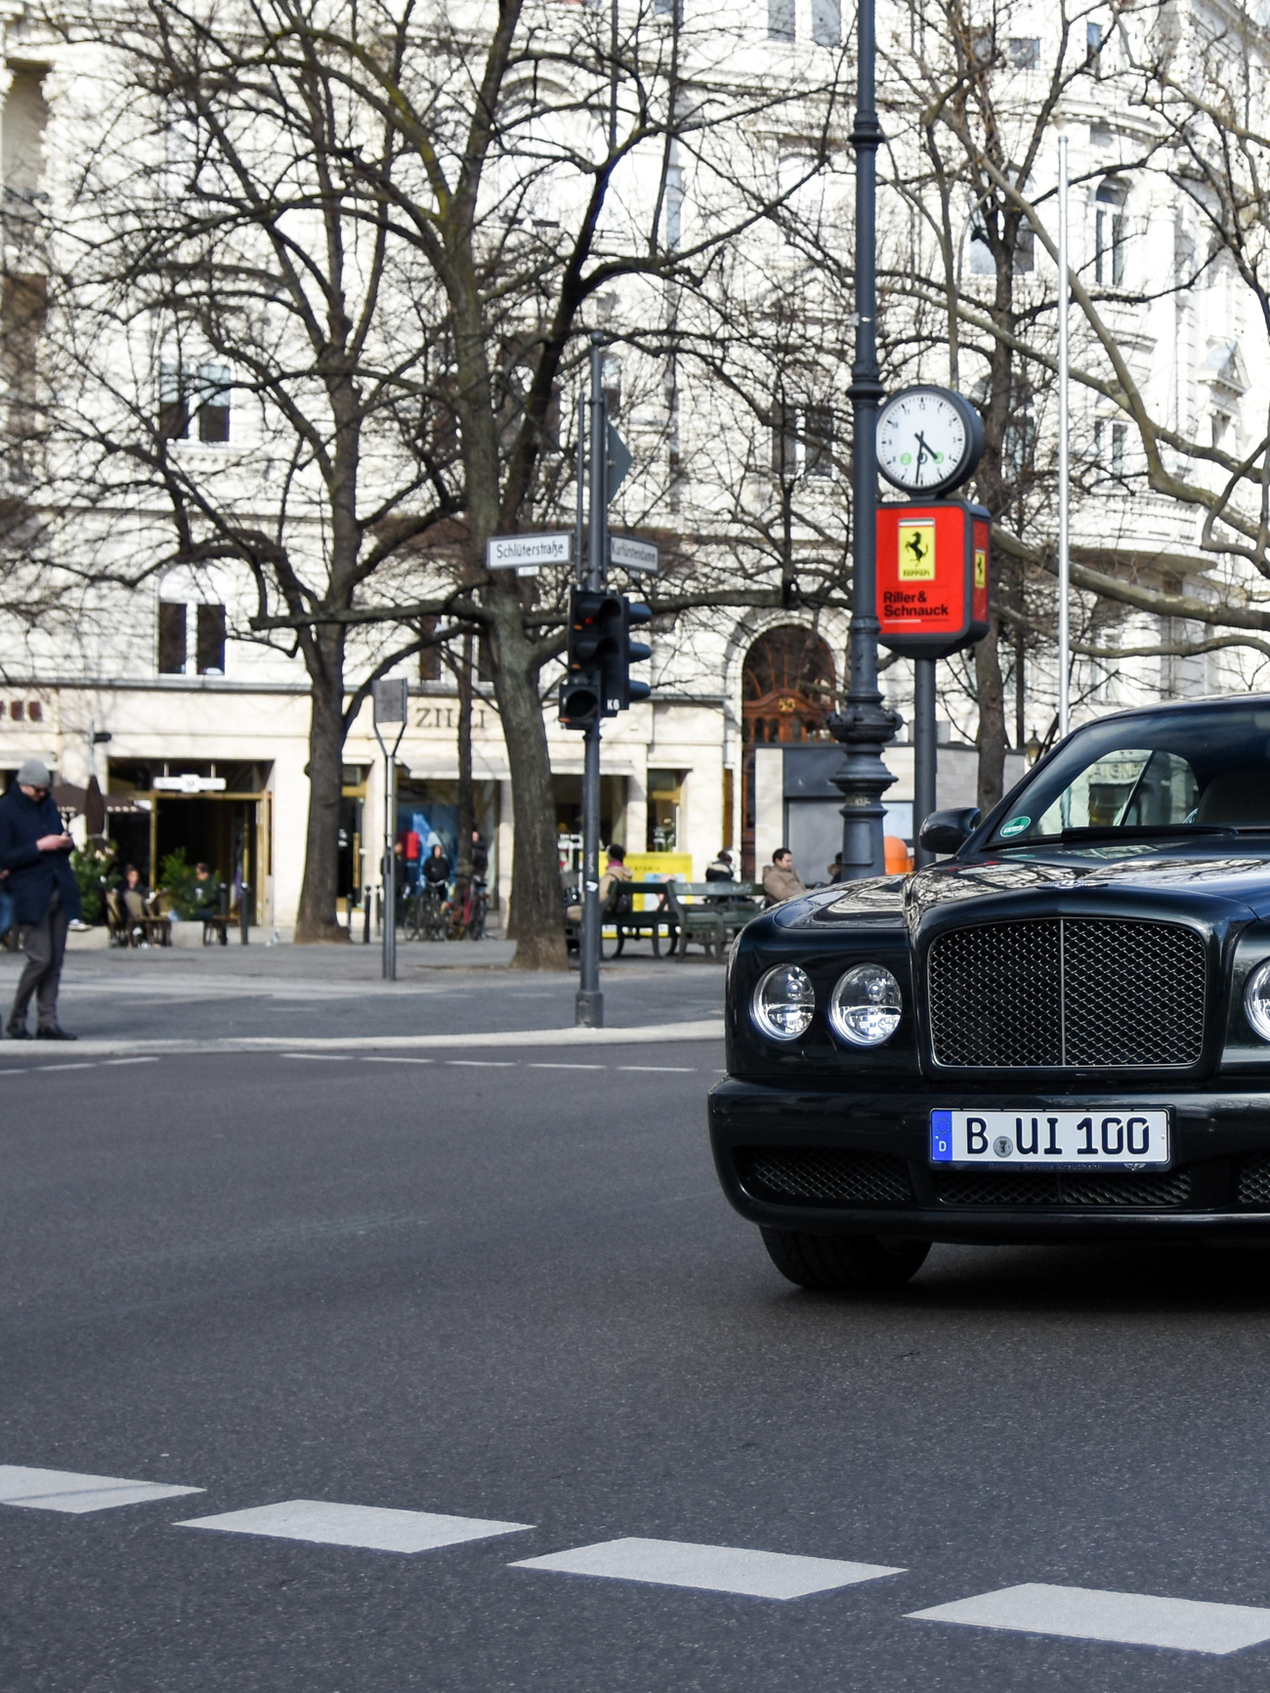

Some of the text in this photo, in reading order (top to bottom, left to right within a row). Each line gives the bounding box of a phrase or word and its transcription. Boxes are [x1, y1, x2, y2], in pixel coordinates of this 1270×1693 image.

[496, 540, 564, 559] Schlüterstraße
[883, 590, 927, 603] Riller &
[883, 603, 949, 617] Schnauck
[416, 707, 485, 729] ZILI
[966, 1117, 1150, 1155] B UI 100
[939, 1140, 947, 1152] D
[1023, 1162, 1054, 1170] Service
